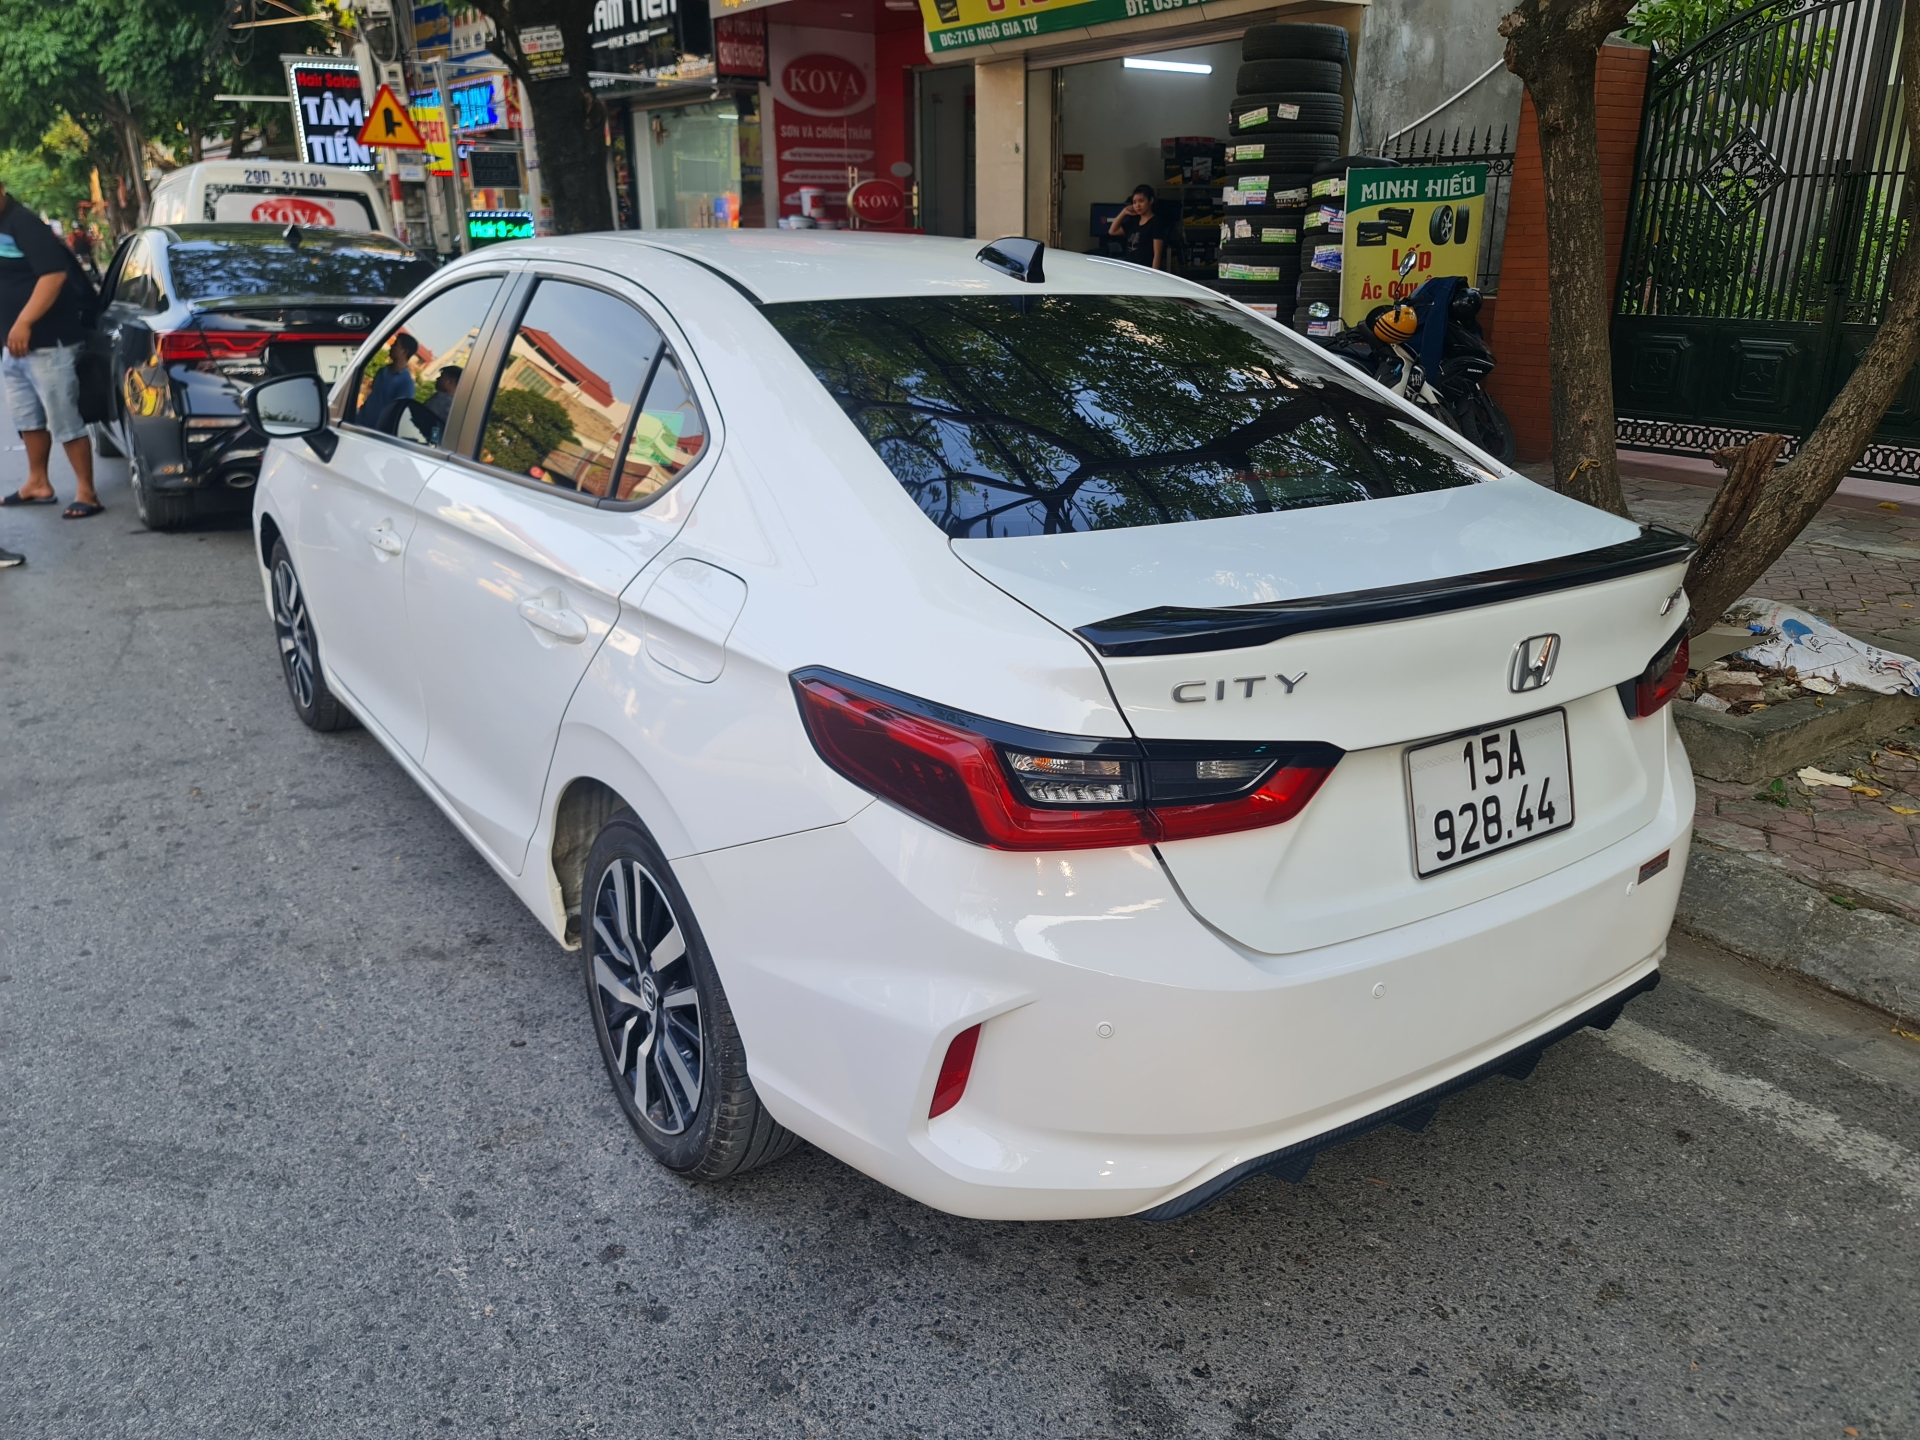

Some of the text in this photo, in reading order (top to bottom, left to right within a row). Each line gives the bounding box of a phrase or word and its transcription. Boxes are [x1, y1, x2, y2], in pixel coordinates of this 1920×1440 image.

[976, 22, 1001, 41] NGÔ
[1001, 20, 1022, 36] GIA
[1022, 16, 1039, 35] TỰ
[297, 72, 361, 89] Hair Salon
[789, 68, 860, 95] KOVA
[302, 91, 365, 127] TÂM
[307, 127, 371, 164] TIẾN
[858, 195, 899, 208] KOVA
[1360, 170, 1476, 203] MINH HIẾU
[255, 207, 327, 226] KOVA
[1360, 275, 1382, 300] Ắc
[1170, 670, 1308, 704] CITY
[1463, 728, 1526, 791] 15A
[1433, 776, 1556, 862] 928.44
